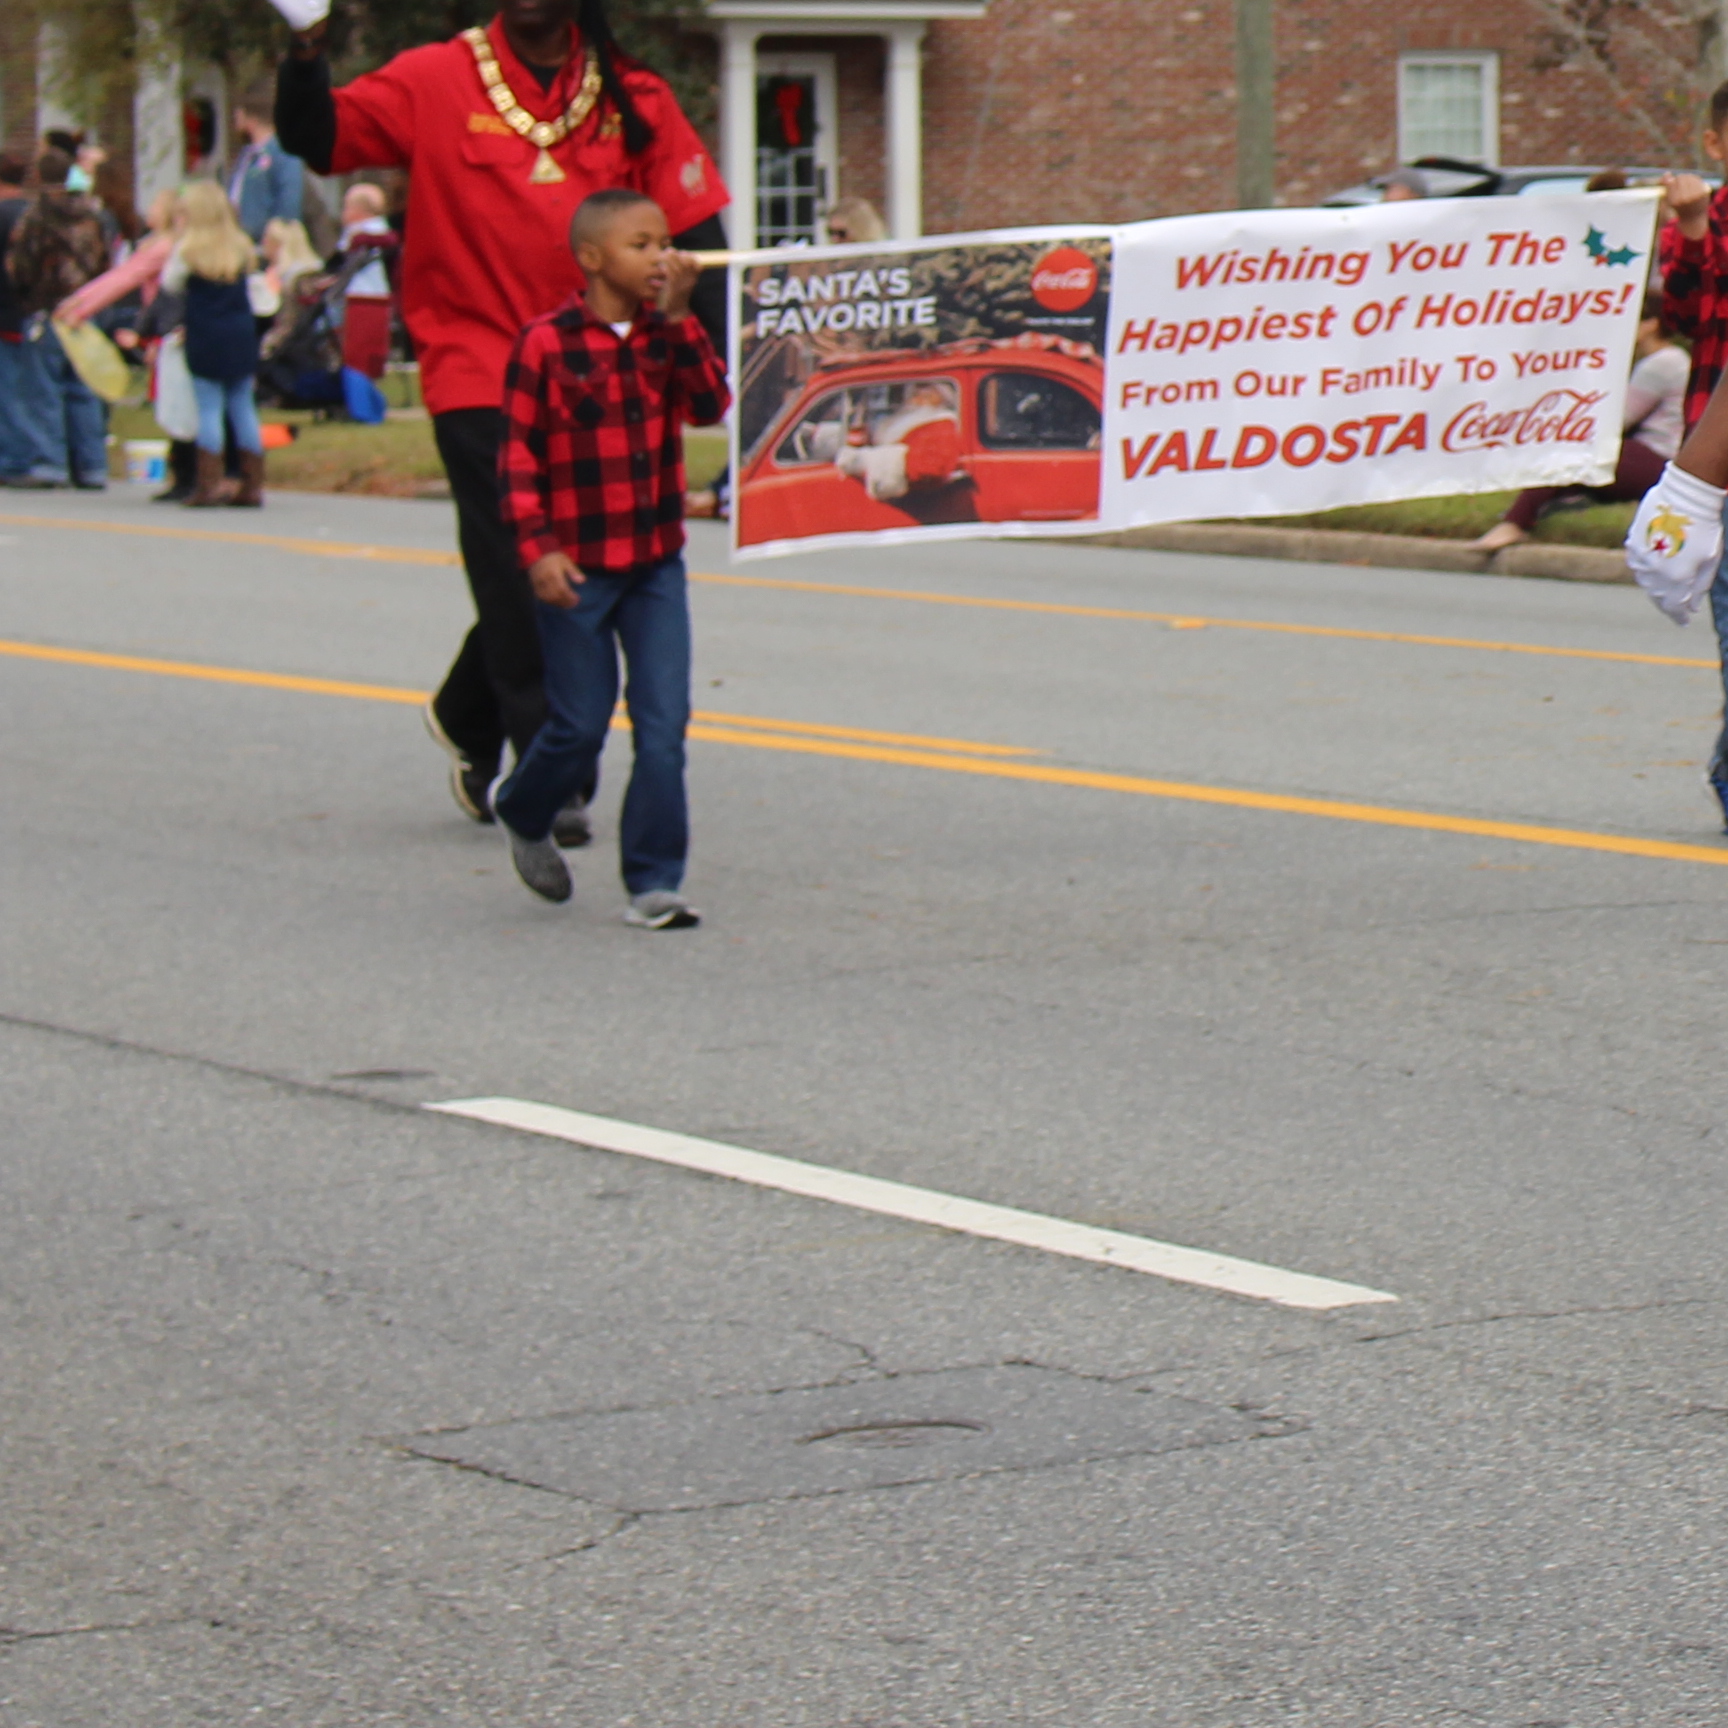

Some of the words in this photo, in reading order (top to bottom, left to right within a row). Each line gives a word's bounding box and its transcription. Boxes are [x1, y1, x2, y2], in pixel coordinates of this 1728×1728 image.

[758, 268, 912, 307] SANTA'S
[1177, 247, 1371, 290] Wishing
[1388, 240, 1469, 274] You
[1487, 231, 1567, 266] The
[756, 296, 938, 339] FAVORITE
[1118, 305, 1337, 355] Happiest
[1352, 296, 1408, 336] Of
[1415, 283, 1635, 328] Holidays!
[1121, 379, 1219, 409] From
[1234, 370, 1306, 397] Our
[1320, 358, 1442, 396] Family
[1456, 355, 1497, 382] To
[1512, 347, 1606, 377] Yours
[1121, 412, 1427, 481] VALDOSTA
